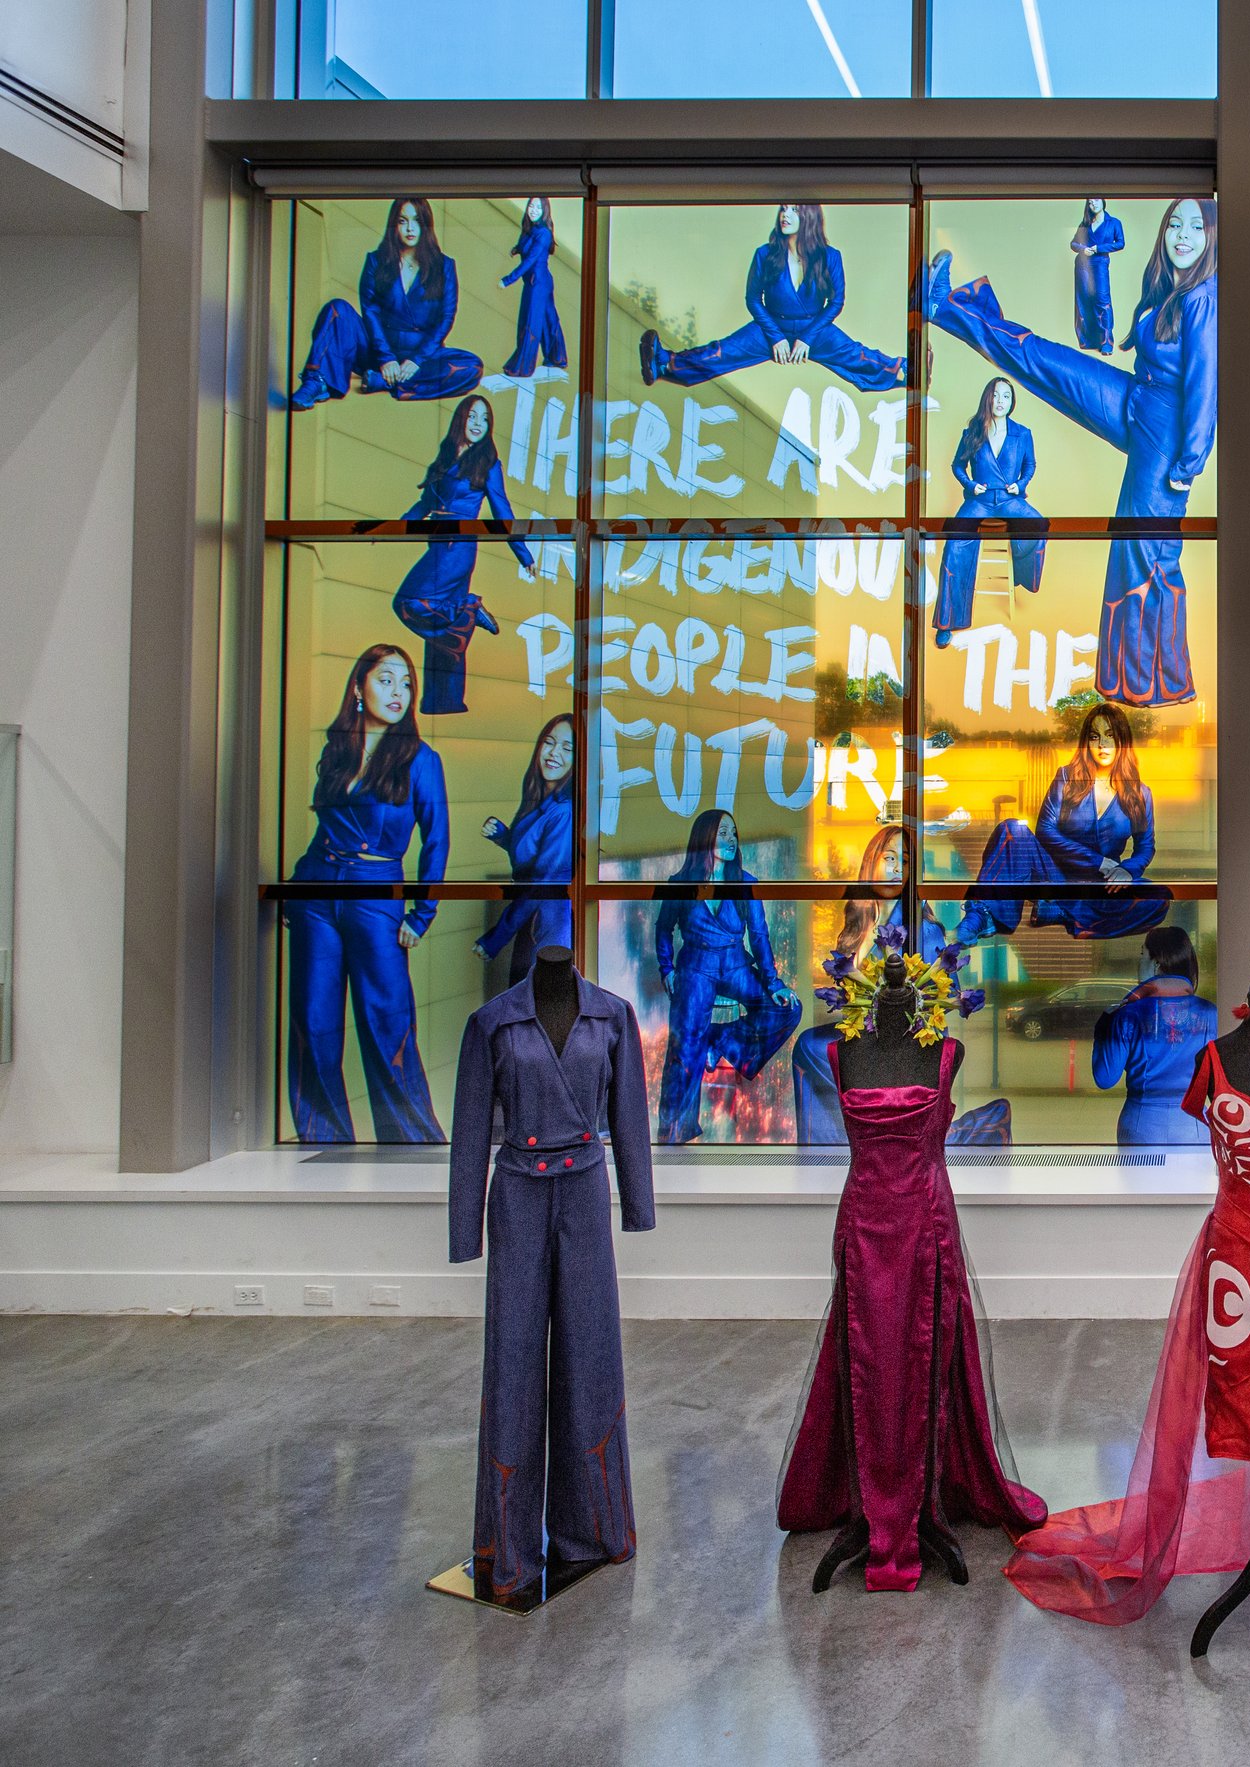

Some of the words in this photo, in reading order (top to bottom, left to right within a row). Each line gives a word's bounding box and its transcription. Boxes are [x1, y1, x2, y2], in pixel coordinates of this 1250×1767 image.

[479, 365, 745, 498] THERE
[766, 385, 941, 496] ARE
[511, 510, 938, 608] INDIGENOUS
[515, 612, 819, 703] PEOPLE
[844, 623, 911, 706] IN
[950, 623, 1101, 716] THE
[584, 705, 972, 837] FUTURE
